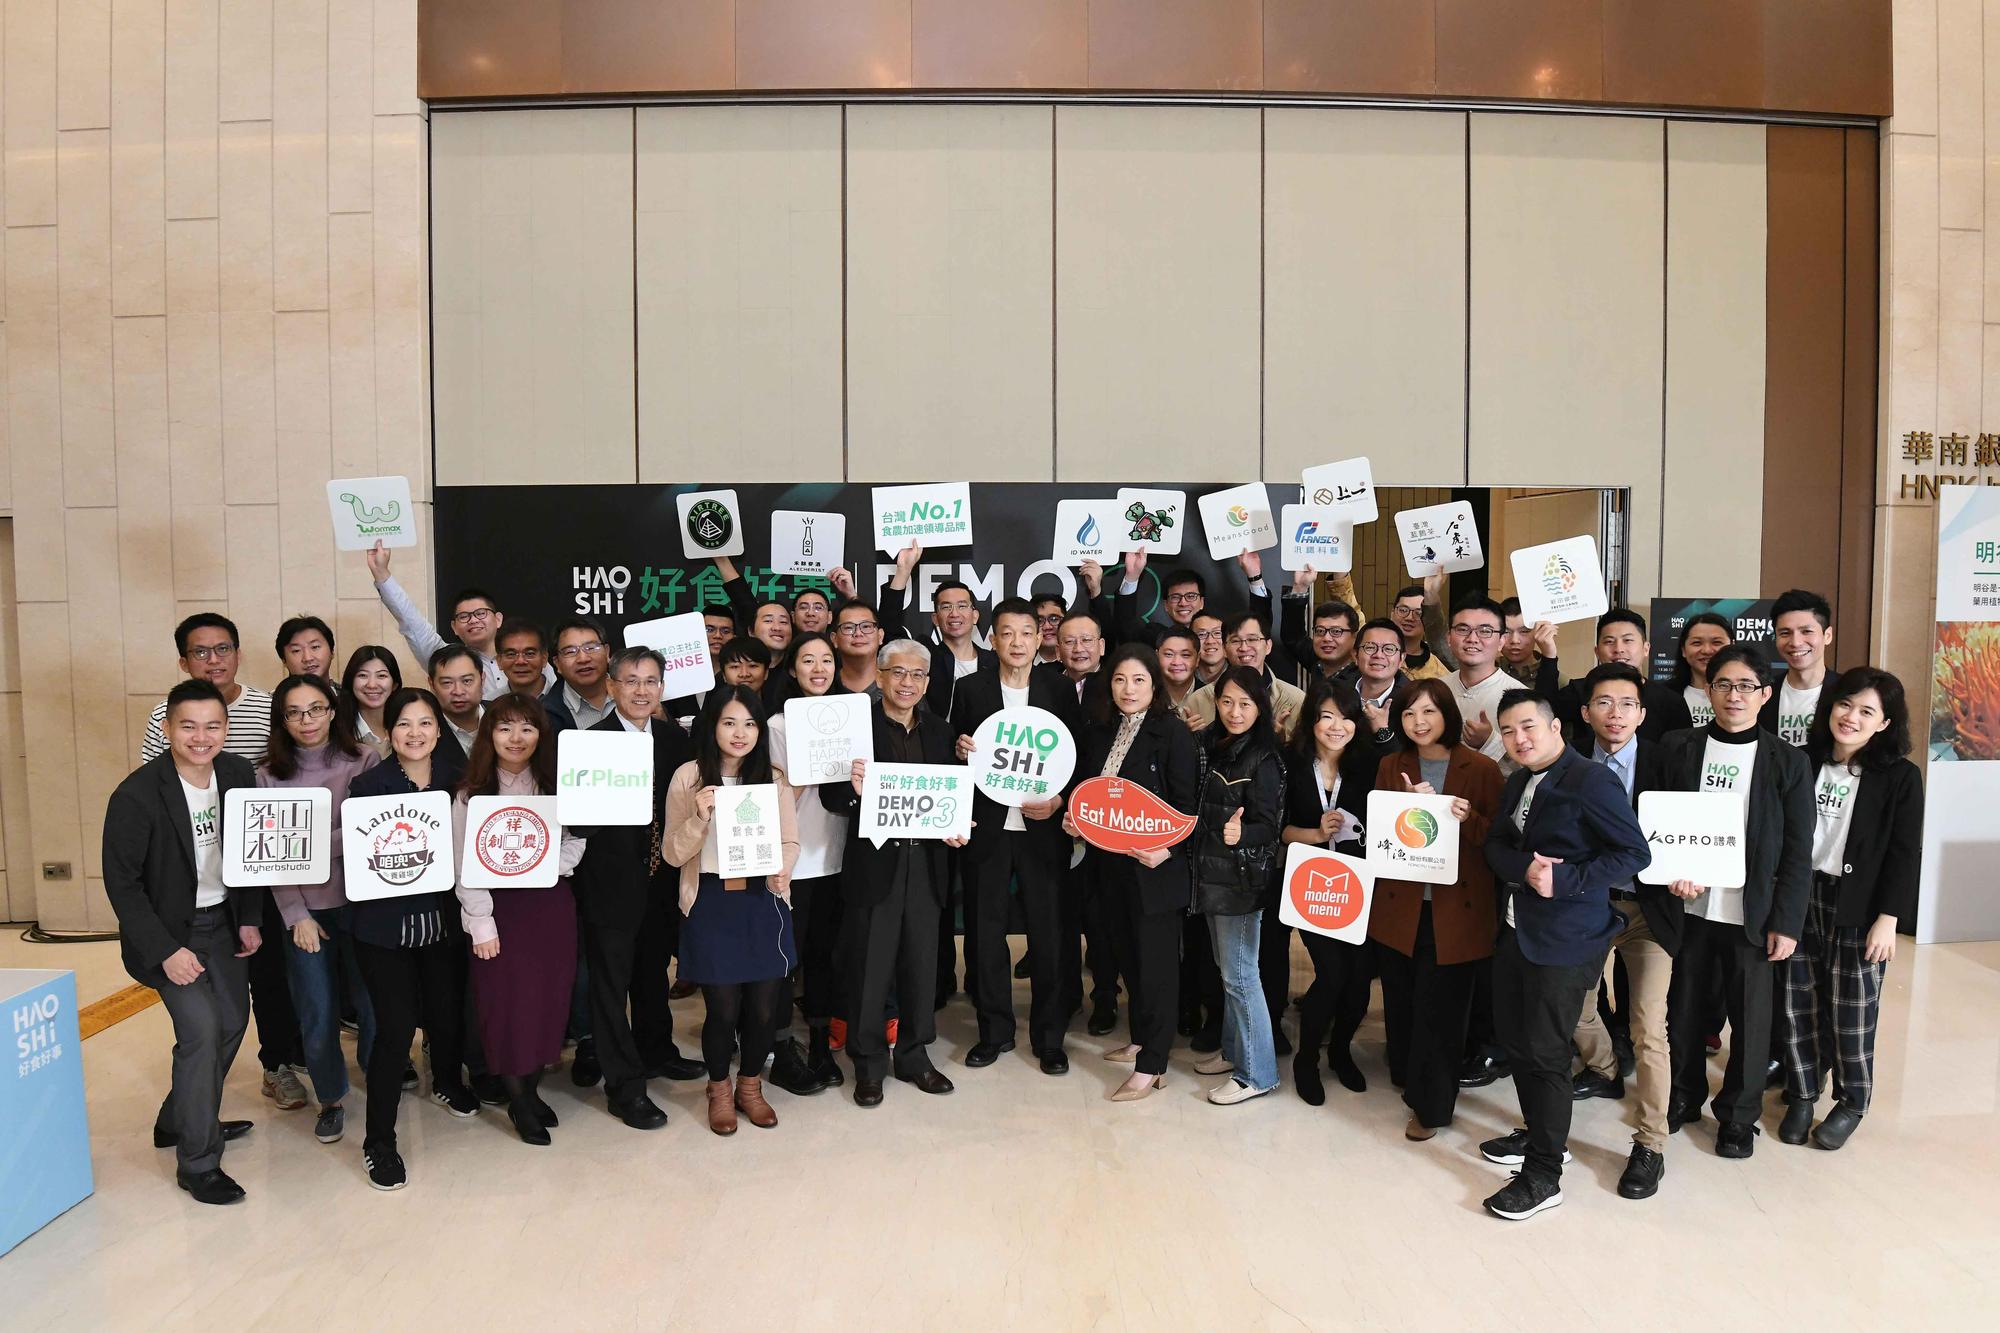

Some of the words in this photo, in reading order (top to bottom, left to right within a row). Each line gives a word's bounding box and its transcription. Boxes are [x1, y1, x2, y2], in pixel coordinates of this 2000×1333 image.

[690, 502, 730, 522] AIRTREE
[882, 511, 906, 523] 台灣
[910, 499, 962, 521] No.1
[356, 524, 401, 533] Wormax
[882, 521, 966, 536] 食農加速領導品牌
[1976, 541, 2000, 563] 明
[573, 566, 632, 589] HAO
[1973, 584, 2000, 593] 明谷是
[1736, 630, 1765, 641] DAY
[1692, 715, 1712, 724] SH
[995, 721, 1059, 752] HAO
[809, 747, 851, 761] HAPPY
[561, 768, 649, 787] dr.Plant
[1707, 763, 1740, 777] HAO
[880, 774, 898, 782] HAO
[900, 774, 958, 791] 好食好事
[985, 772, 1049, 795] 好食好事
[1820, 782, 1850, 797] HAO
[878, 795, 934, 813] DEMO
[356, 803, 440, 837] Landoue
[877, 812, 913, 827] DAY
[1080, 801, 1105, 825] Eat
[1108, 807, 1176, 832] Modern.
[196, 821, 215, 837] SH
[506, 817, 522, 832] 祥
[488, 834, 503, 849] 創
[522, 833, 537, 849] 農
[243, 863, 311, 874] Myherbstudio
[1304, 889, 1349, 904] modern
[1308, 903, 1341, 917] menu
[13, 994, 59, 1033] HAO
[18, 1043, 62, 1079] 好食好事
